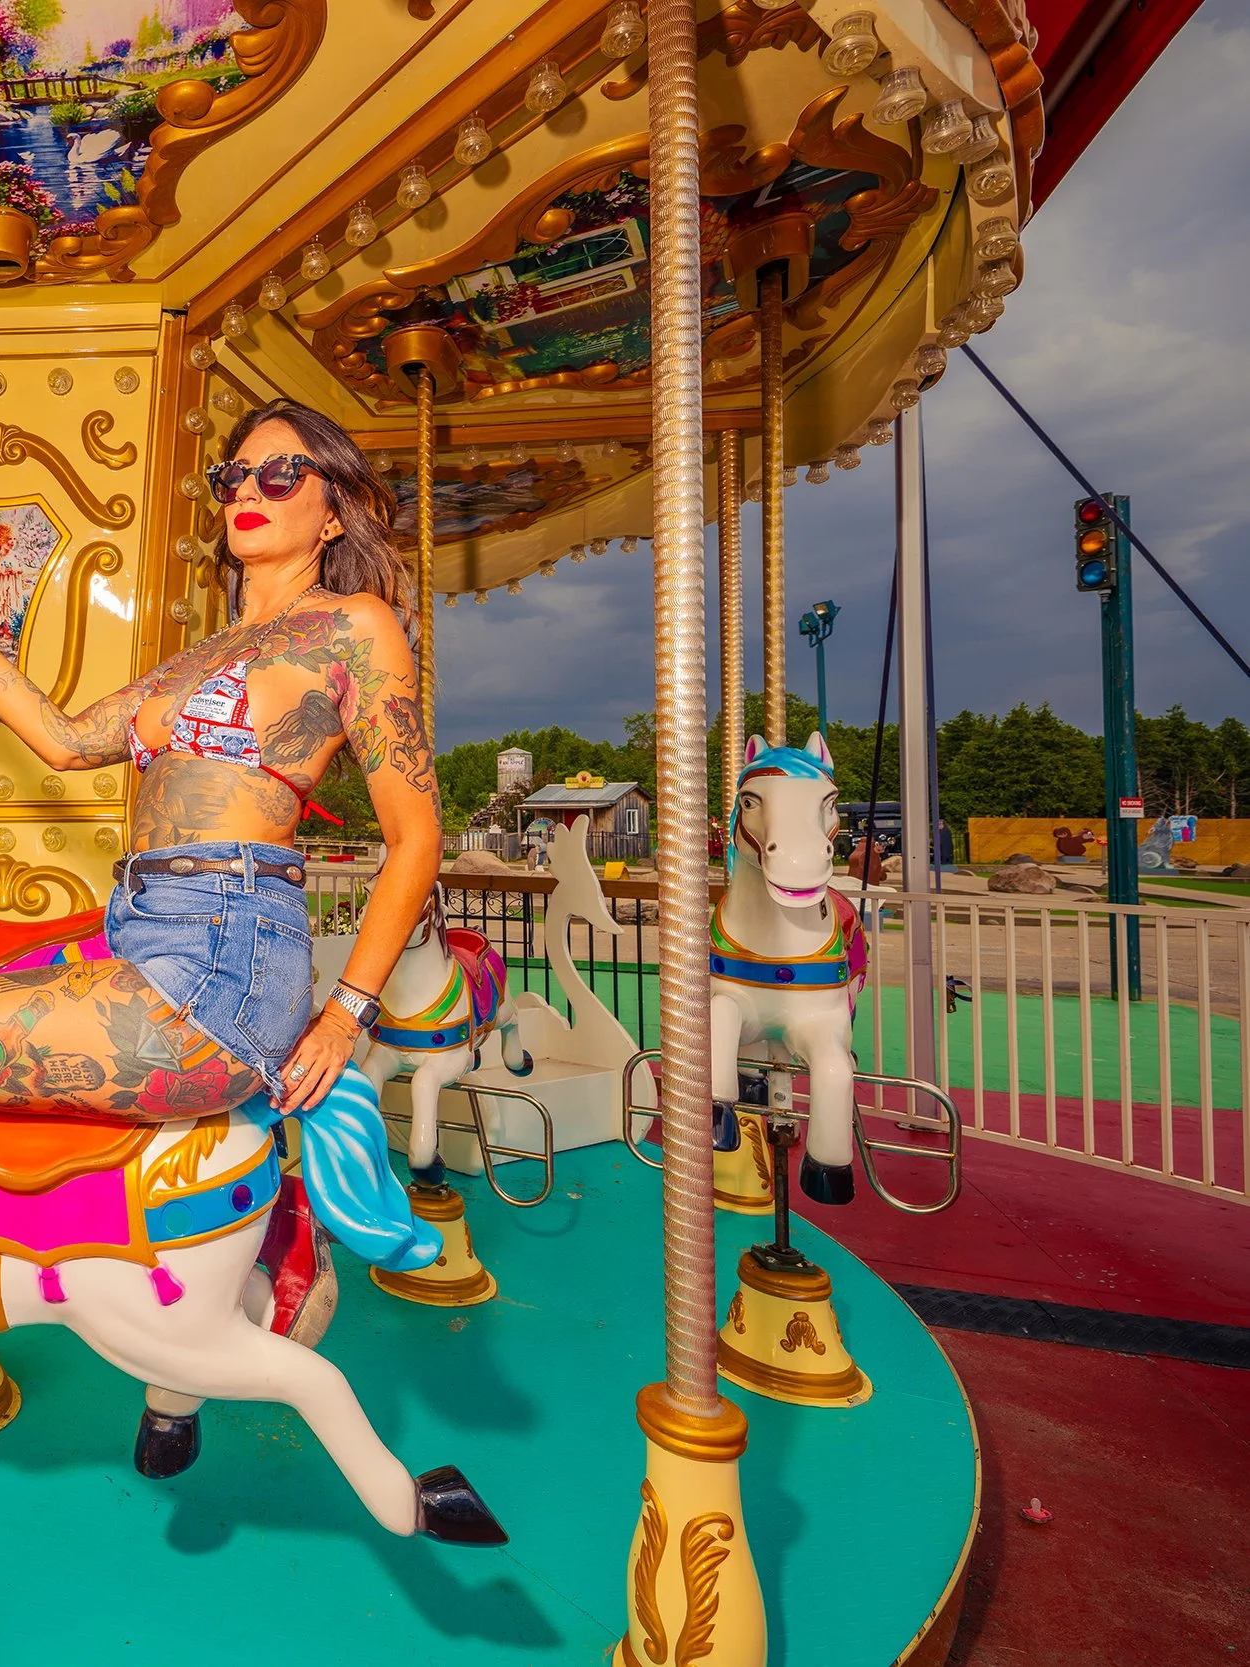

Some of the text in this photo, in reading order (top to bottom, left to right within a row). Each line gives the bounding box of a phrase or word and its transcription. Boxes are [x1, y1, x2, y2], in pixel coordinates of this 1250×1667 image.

[820, 898, 827, 918] 5
[49, 1060, 64, 1084] HERE
[59, 1058, 74, 1084] WERE
[70, 1062, 83, 1083] YOU
[80, 1060, 95, 1086] WISH
